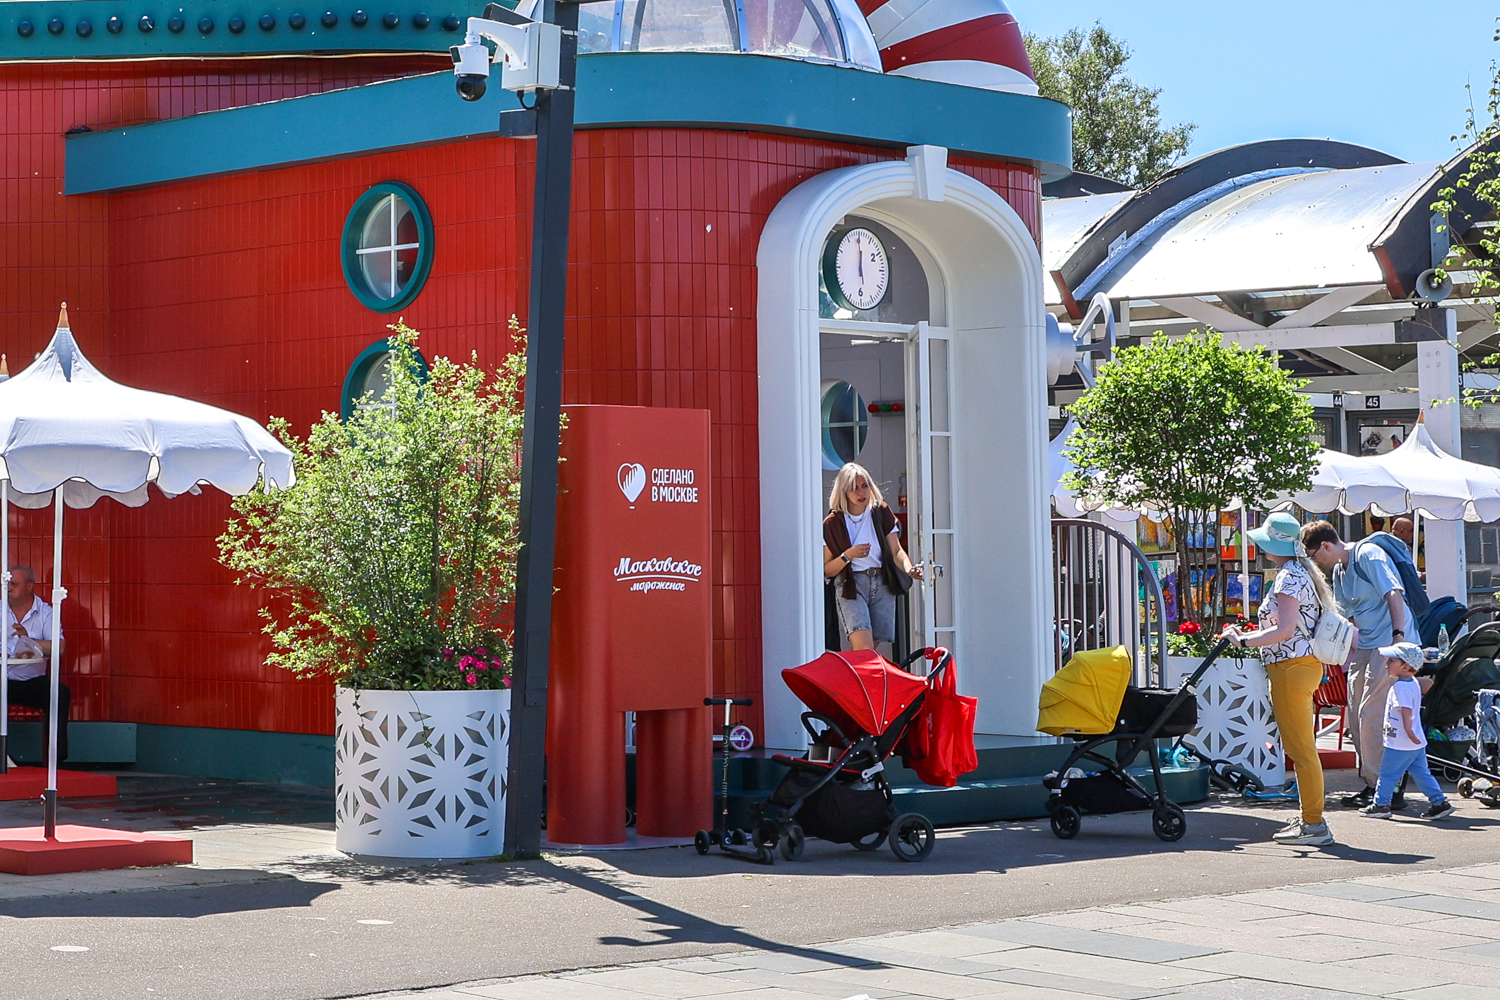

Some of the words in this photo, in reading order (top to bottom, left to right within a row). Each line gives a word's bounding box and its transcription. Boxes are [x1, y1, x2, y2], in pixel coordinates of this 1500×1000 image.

[870, 253, 876, 262] 2
[858, 287, 864, 297] 6
[1366, 397, 1379, 407] 45
[651, 468, 695, 485] СДЕЛАНО
[651, 486, 659, 502] В
[659, 486, 699, 503] МОСКВЕ
[613, 557, 702, 576] Московское
[630, 581, 686, 594] мороженое
